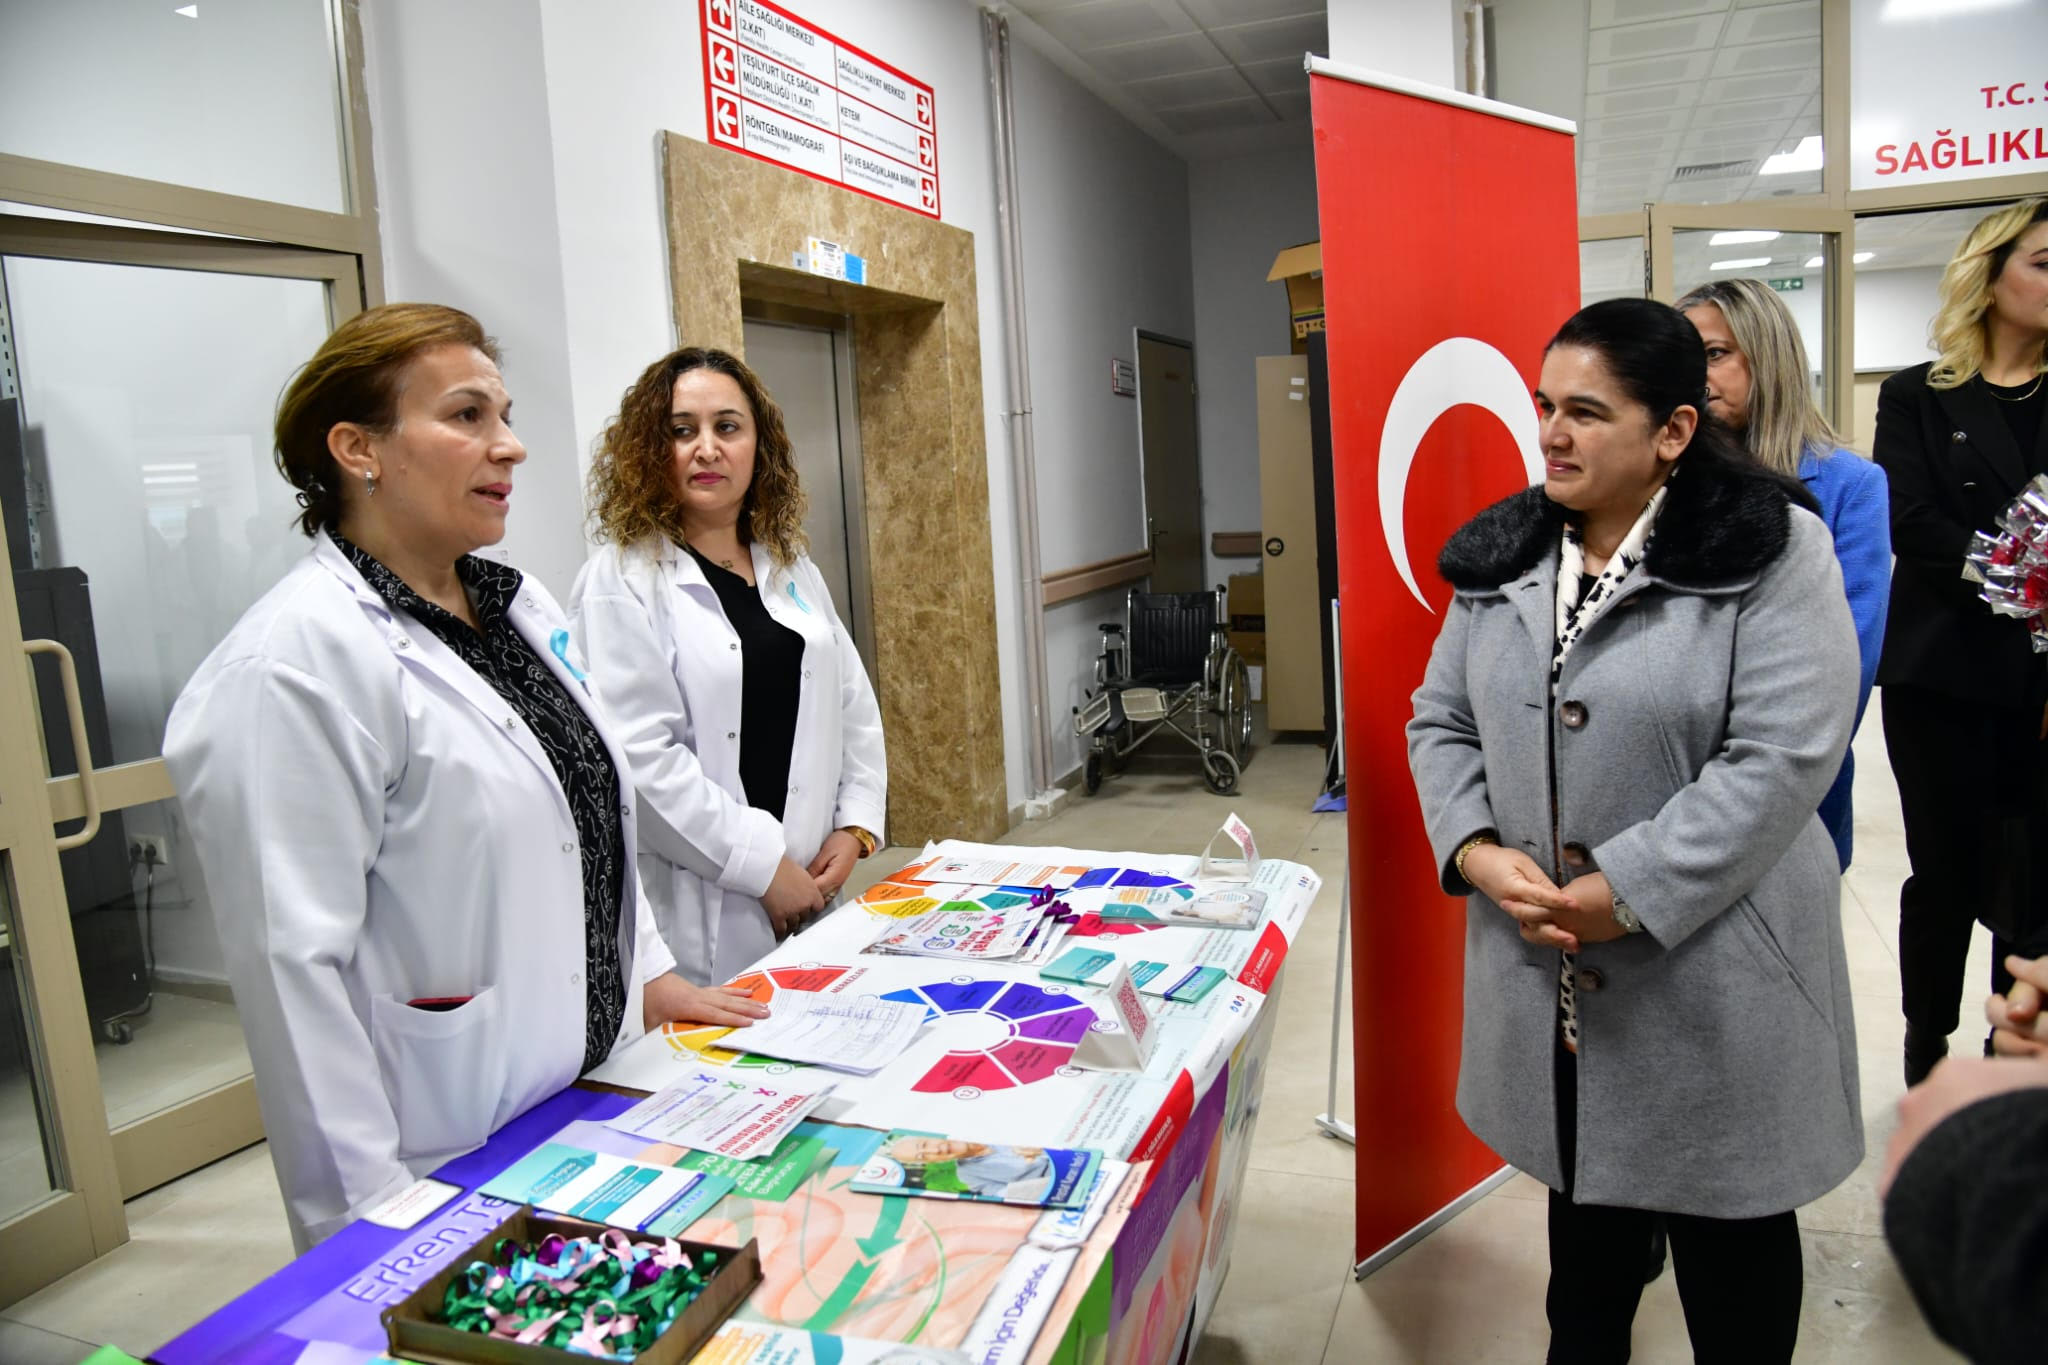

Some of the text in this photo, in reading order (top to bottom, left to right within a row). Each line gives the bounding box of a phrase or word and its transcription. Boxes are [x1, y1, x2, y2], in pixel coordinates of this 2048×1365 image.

[756, 8, 785, 31] SAĞLIĞI
[742, 52, 780, 78] YEŞİLYURT
[796, 77, 820, 96] SAĞLIK
[743, 71, 790, 100] MÜDÜRLÜĞÜ
[1980, 82, 2035, 109] T.C.
[840, 106, 860, 121] KETEM
[341, 1225, 469, 1303] Erken
